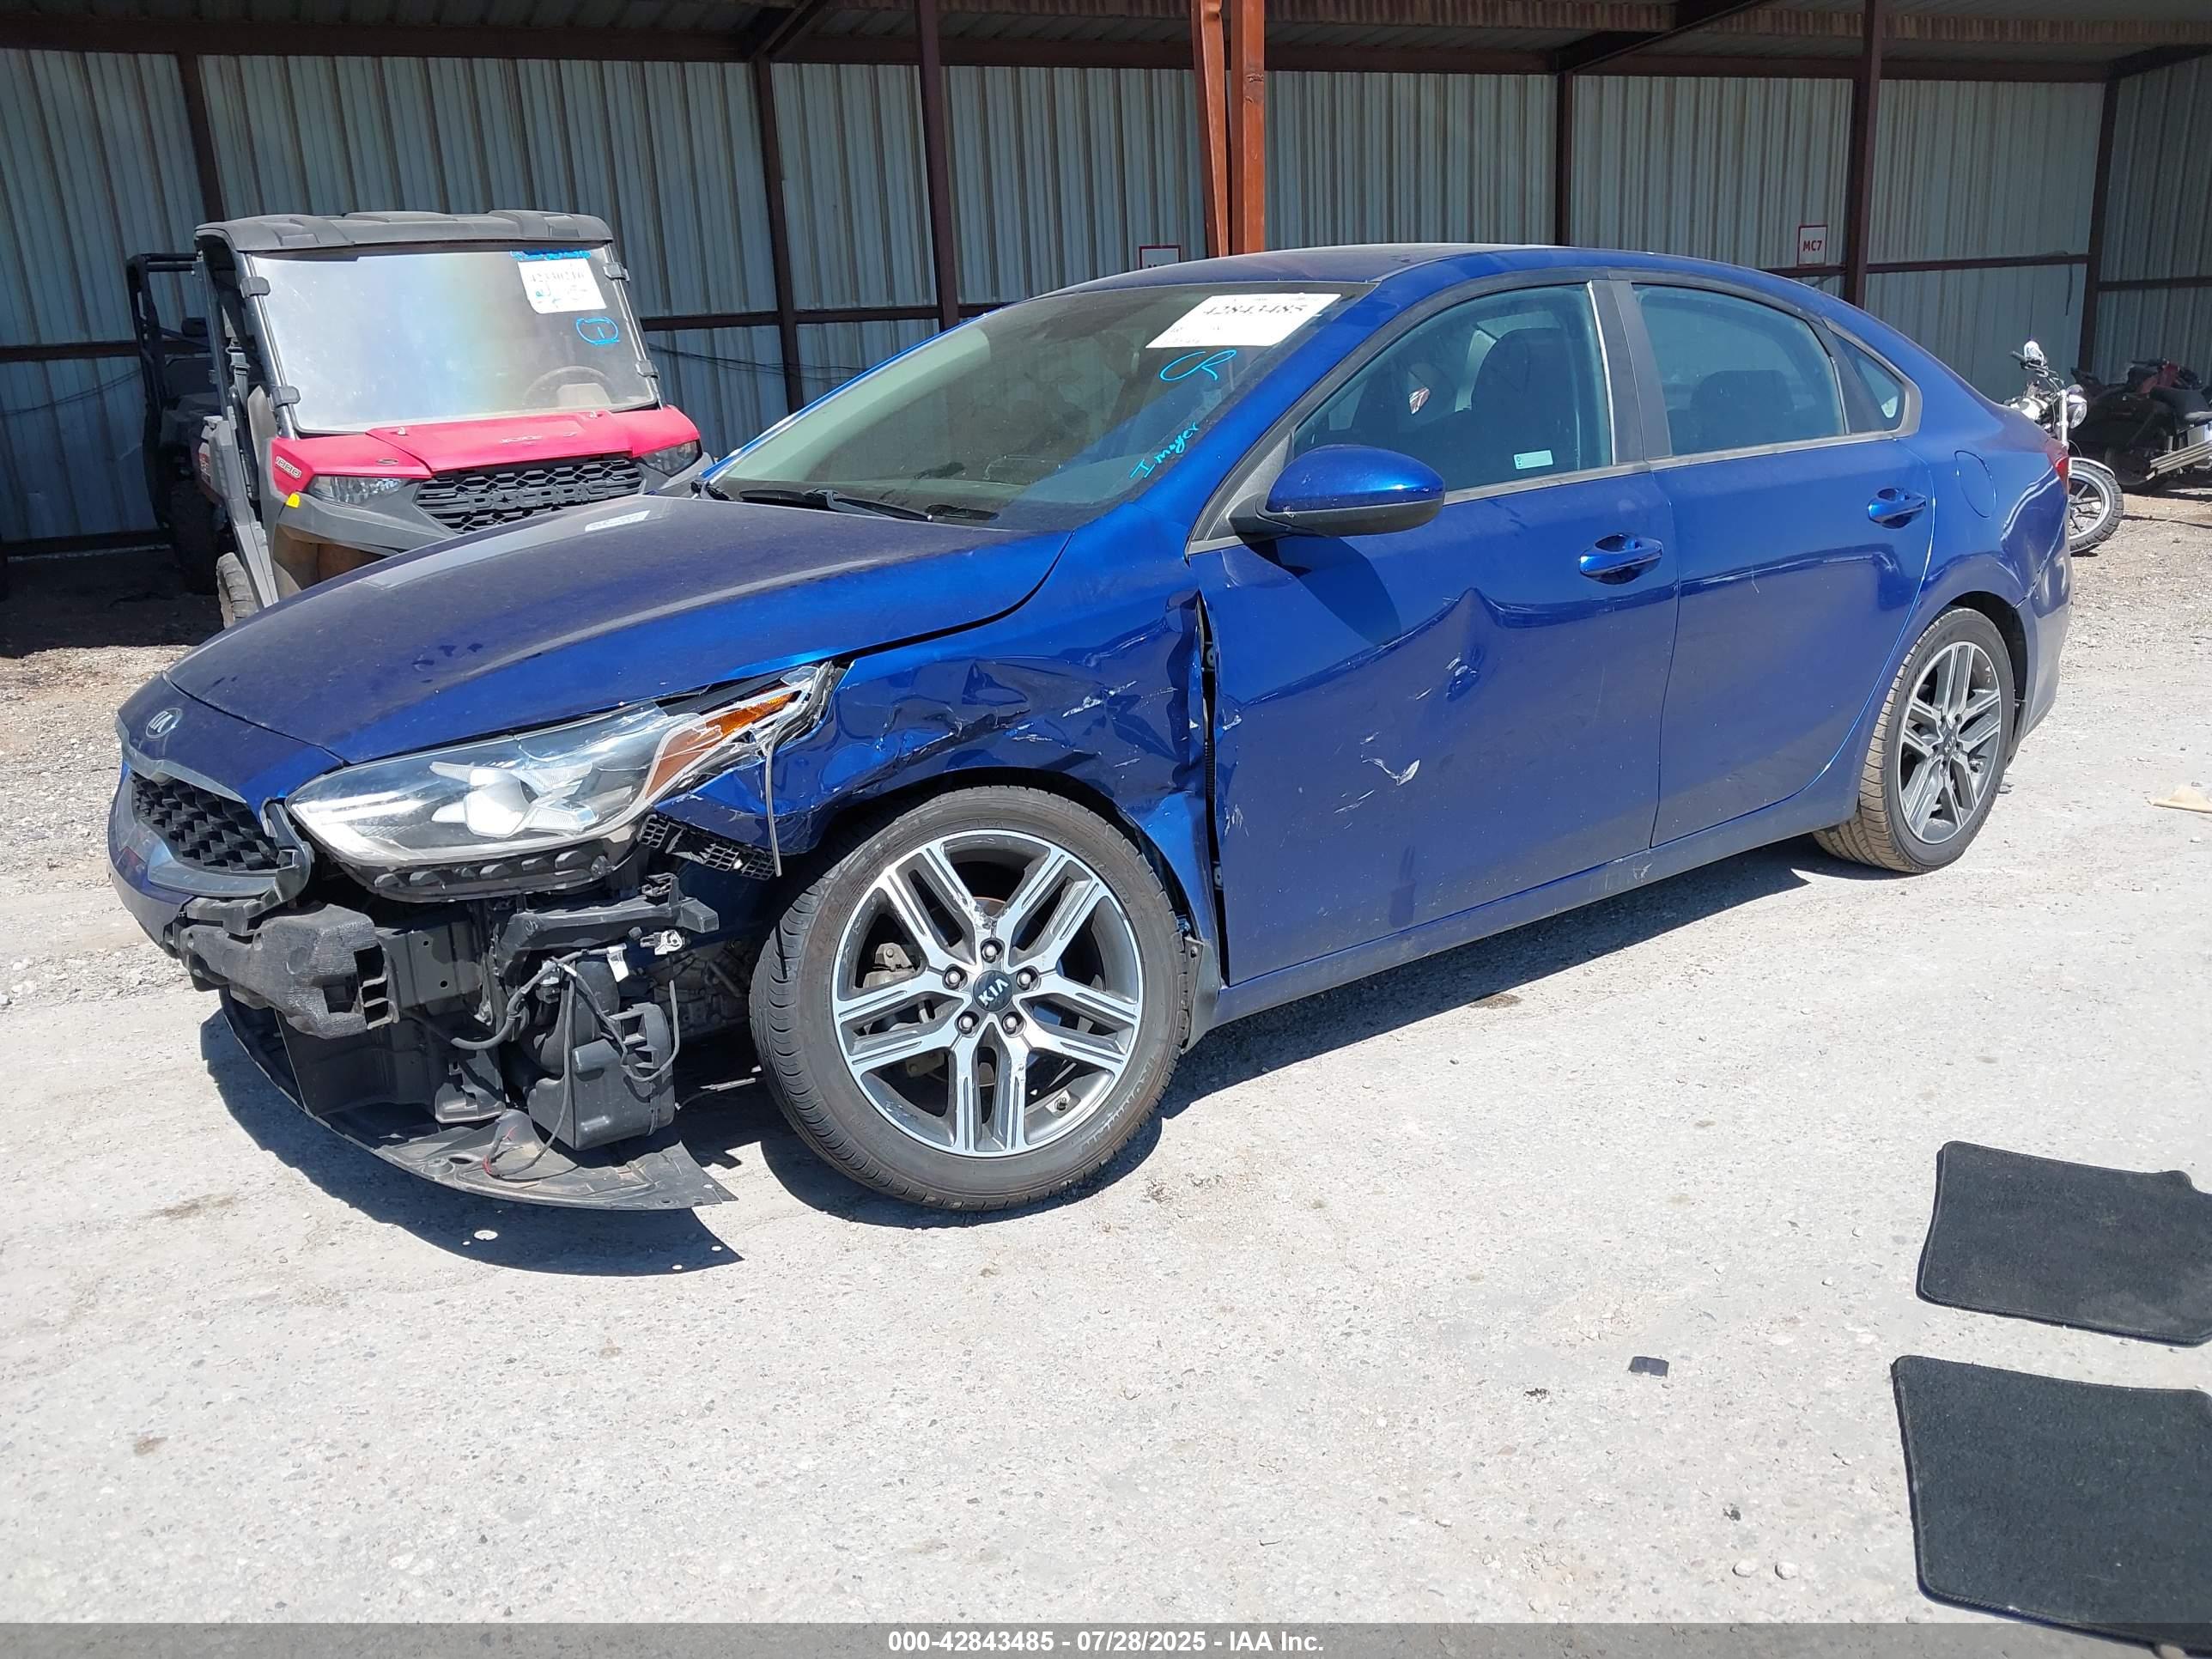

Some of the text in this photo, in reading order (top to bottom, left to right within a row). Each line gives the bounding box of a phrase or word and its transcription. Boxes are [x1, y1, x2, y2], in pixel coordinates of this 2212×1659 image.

[1802, 240, 1822, 252] MC7
[468, 480, 610, 514] POLARIS
[978, 978, 1009, 1006] KIA
